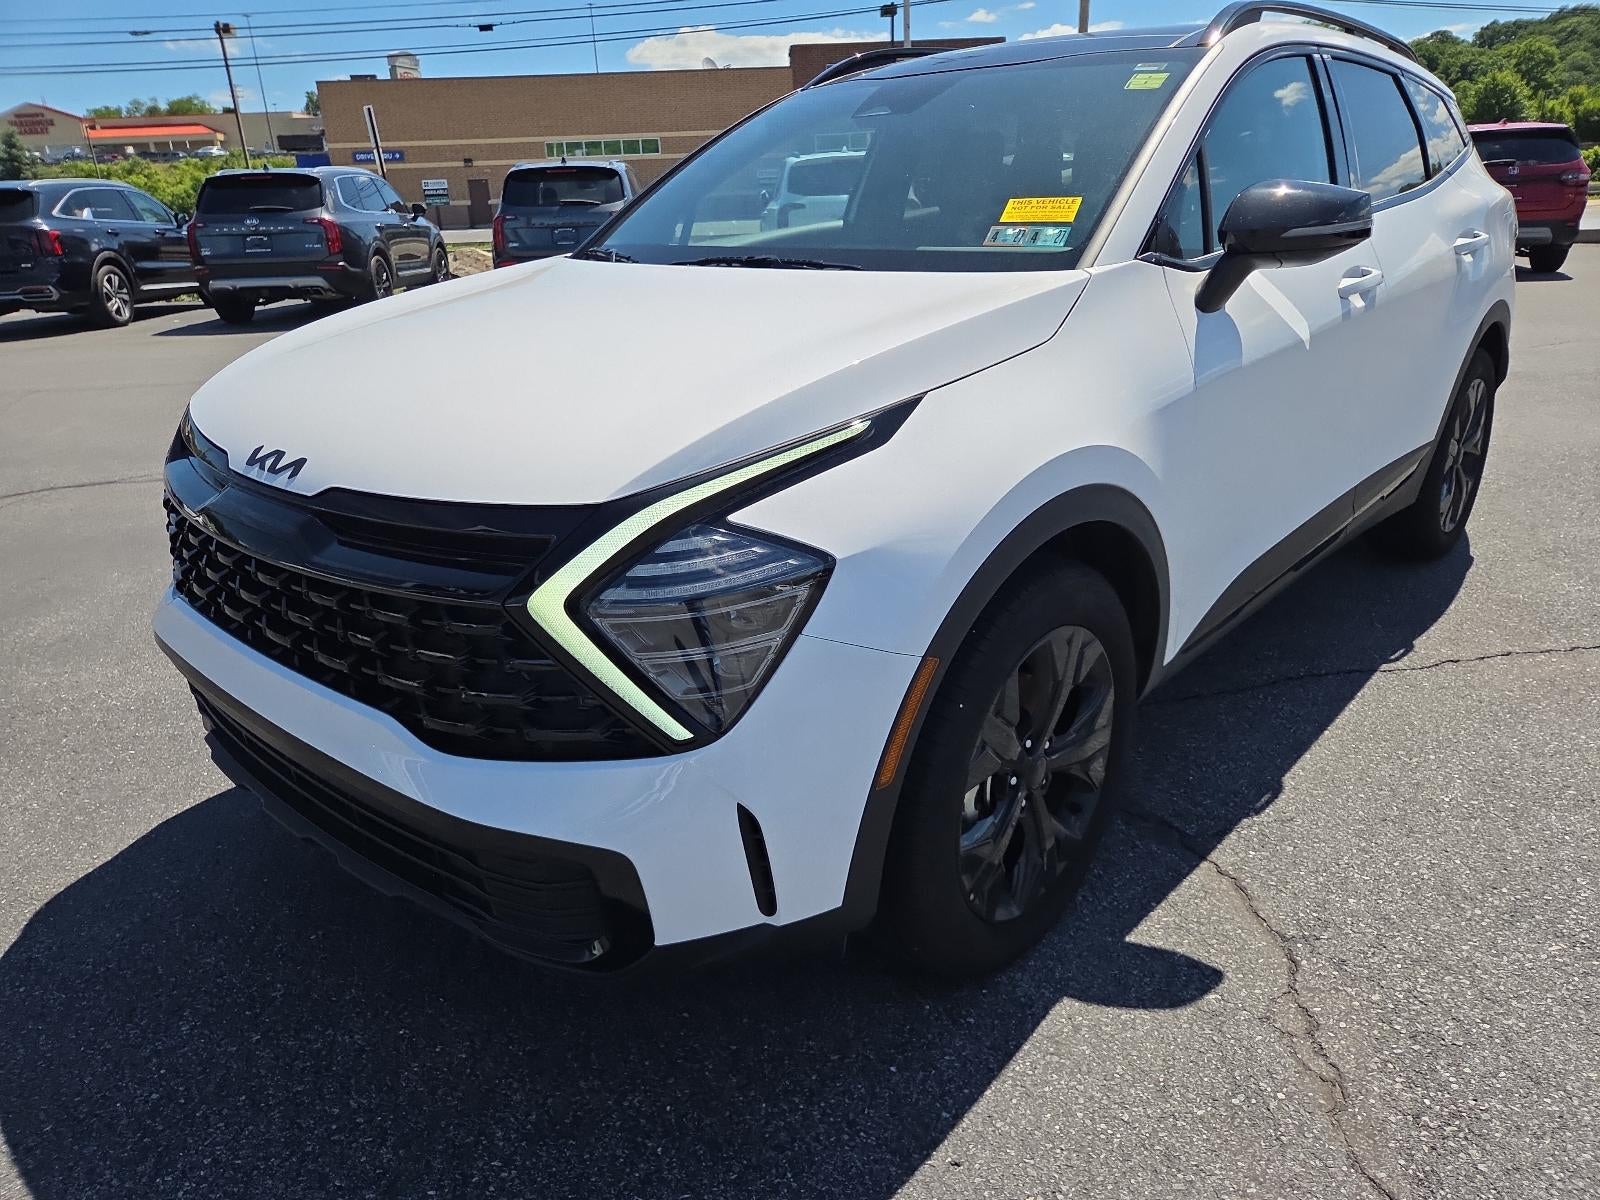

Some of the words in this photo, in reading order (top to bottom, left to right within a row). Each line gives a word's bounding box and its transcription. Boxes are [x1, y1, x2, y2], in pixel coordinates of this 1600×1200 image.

[990, 231, 999, 242] 4
[1013, 229, 1027, 243] 27
[1030, 231, 1039, 243] 4
